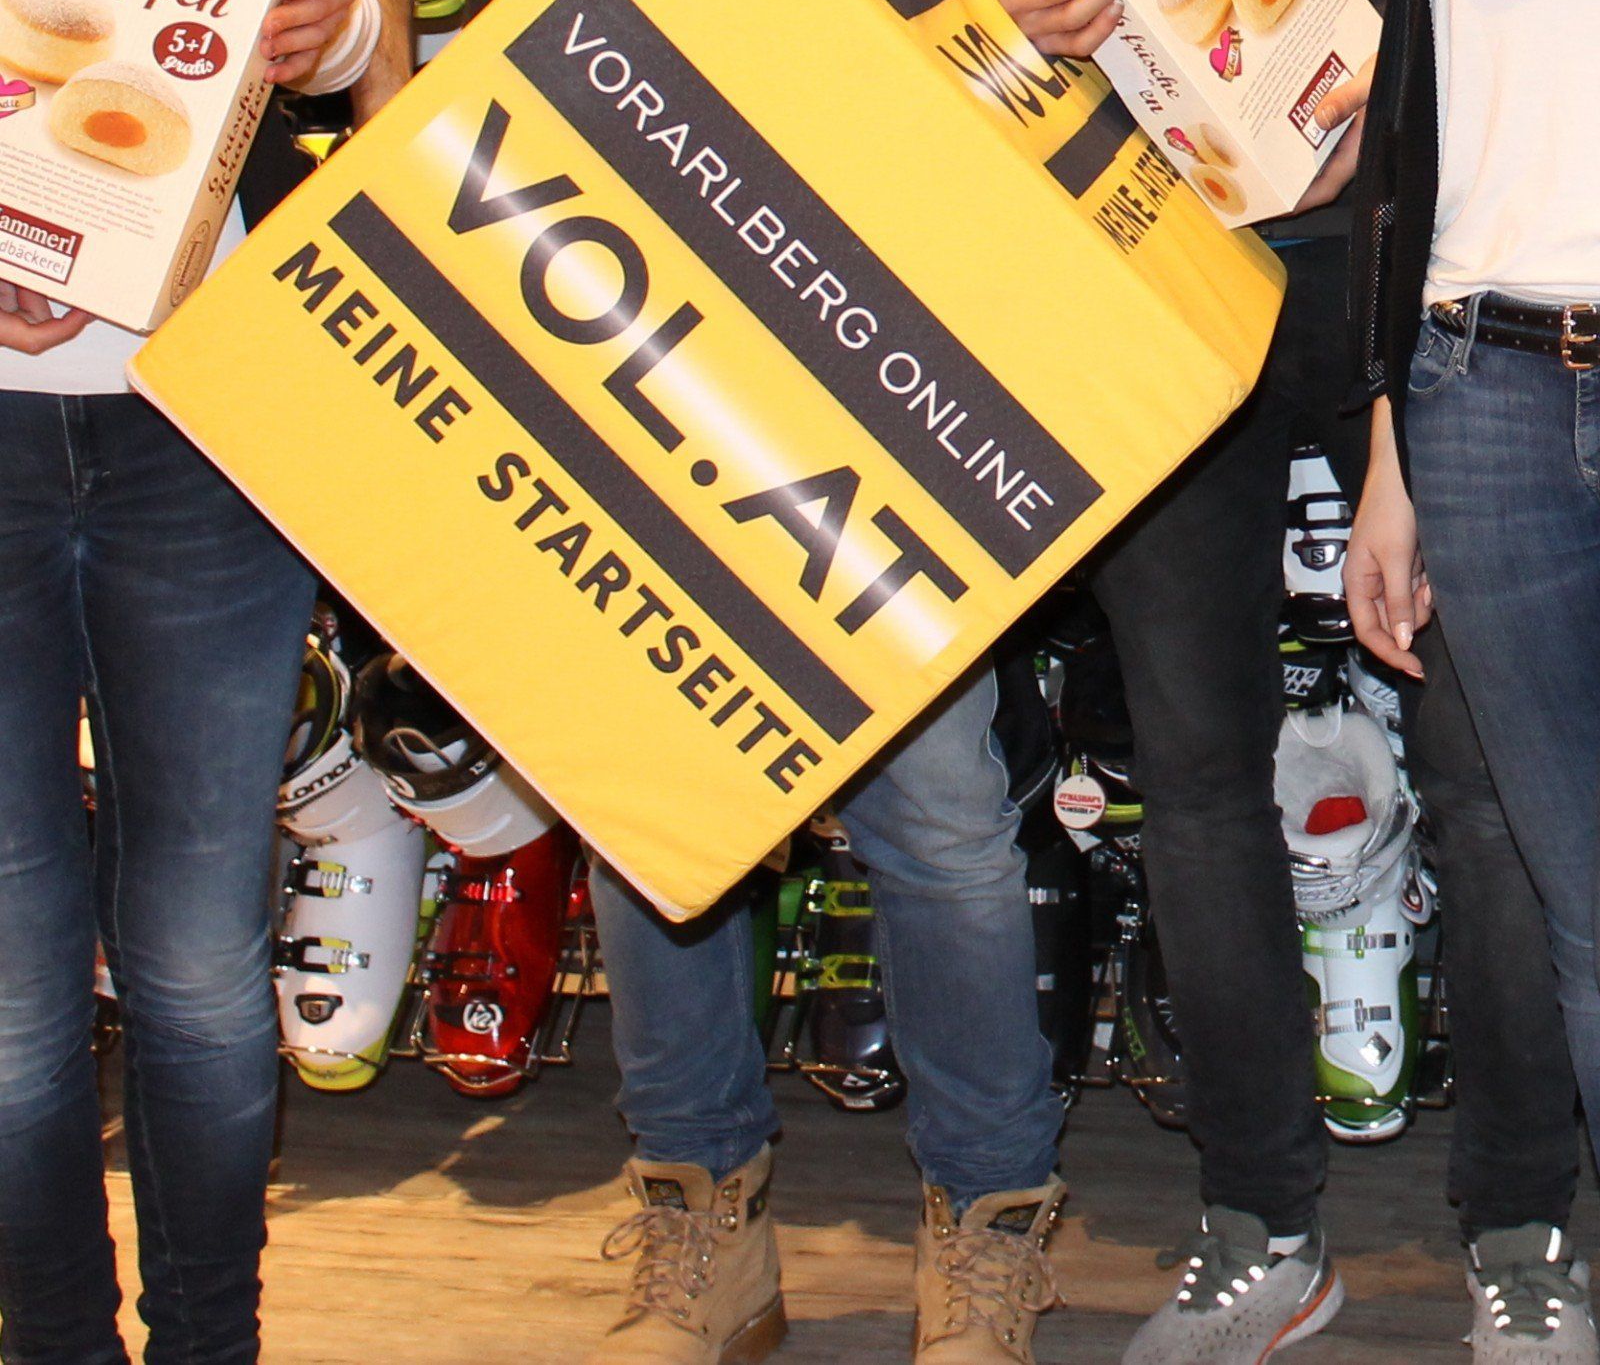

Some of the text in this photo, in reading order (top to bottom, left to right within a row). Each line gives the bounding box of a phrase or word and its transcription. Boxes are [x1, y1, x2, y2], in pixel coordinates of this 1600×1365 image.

[160, 51, 215, 76] gratis
[167, 28, 213, 57] 5+1
[1119, 34, 1180, 101] frische
[1290, 56, 1343, 127] Hammerl
[1092, 184, 1159, 256] MEINE
[0, 239, 68, 275] dbäckerei
[560, 12, 1056, 533] VORARLBERG ONLINE
[444, 95, 971, 638] VOL.AT
[271, 239, 824, 797] MEINE STARTSEITE
